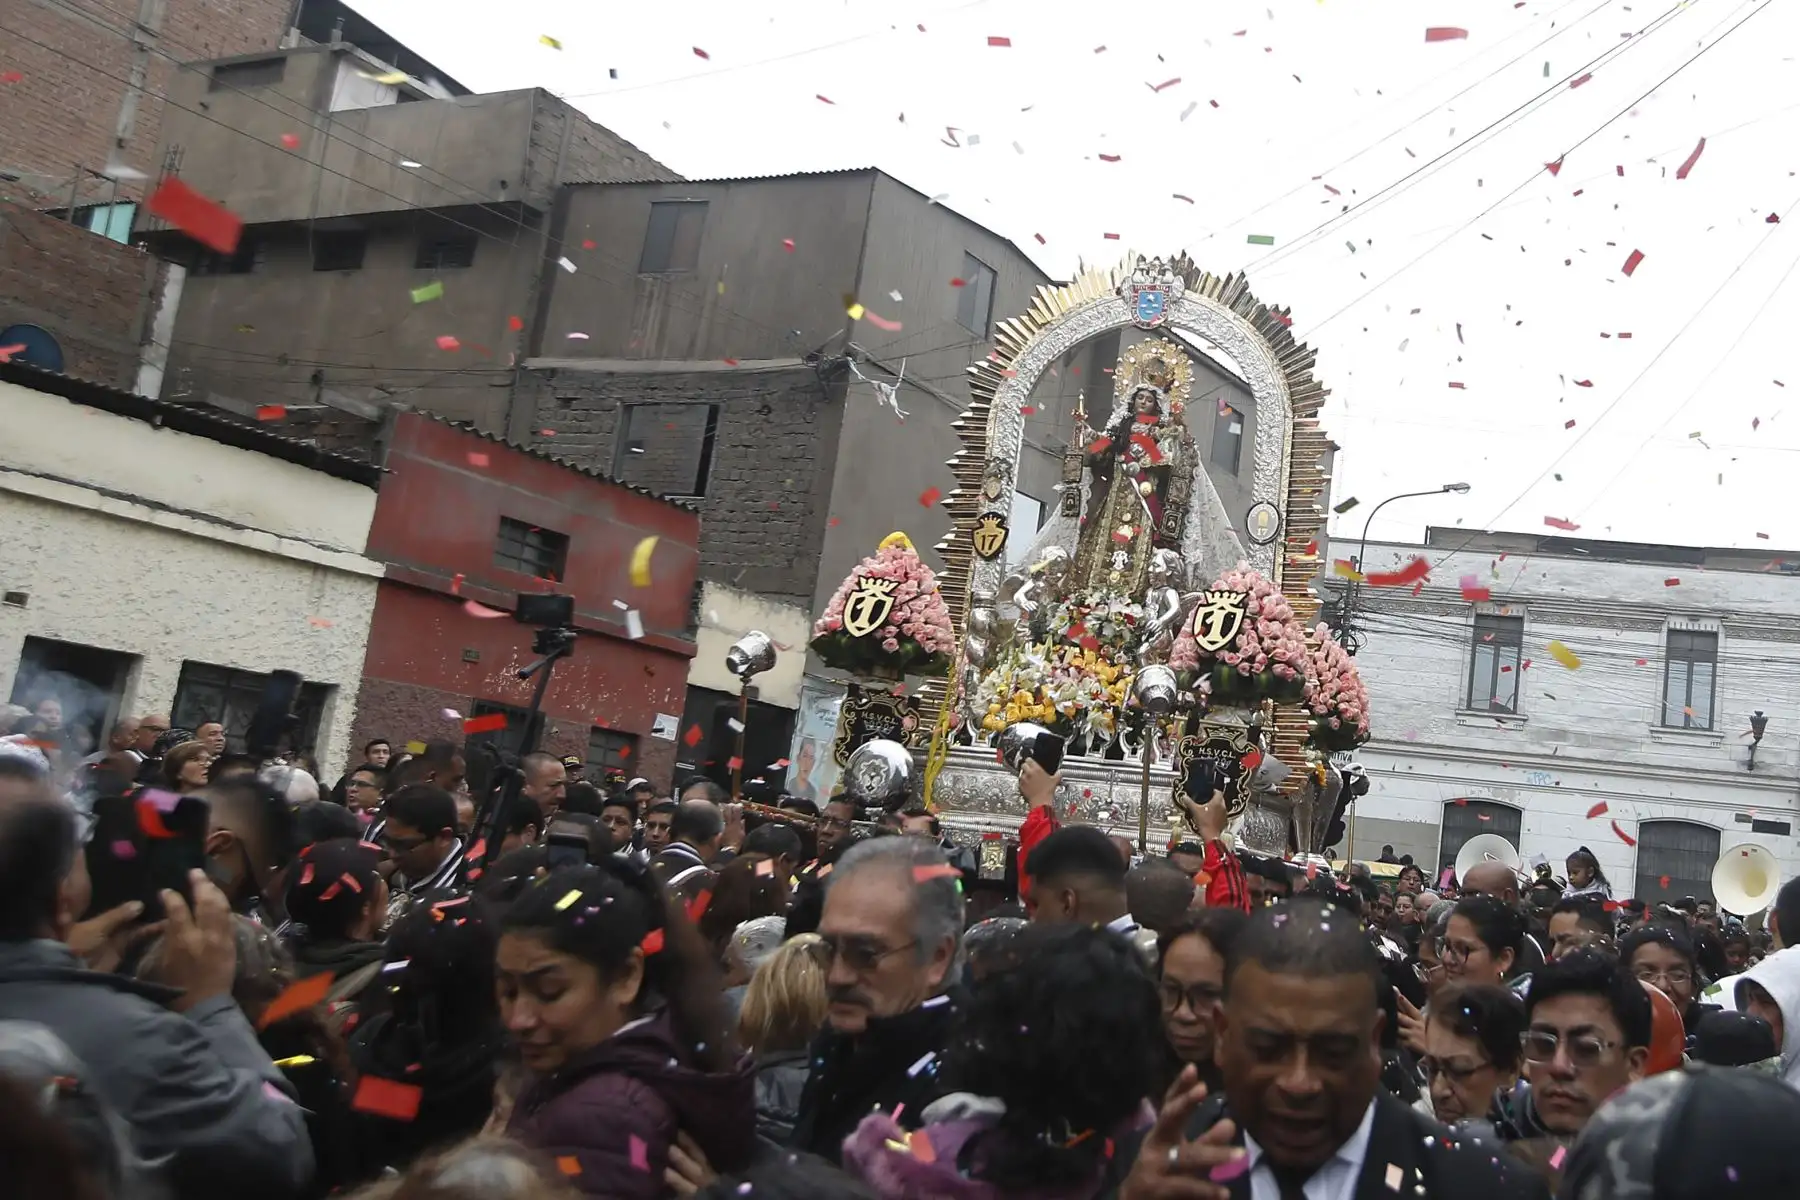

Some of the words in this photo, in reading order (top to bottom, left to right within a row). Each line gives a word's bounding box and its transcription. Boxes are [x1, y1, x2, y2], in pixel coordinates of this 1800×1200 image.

[981, 534, 998, 551] 17
[854, 595, 877, 628] 1
[1205, 610, 1227, 641] 1
